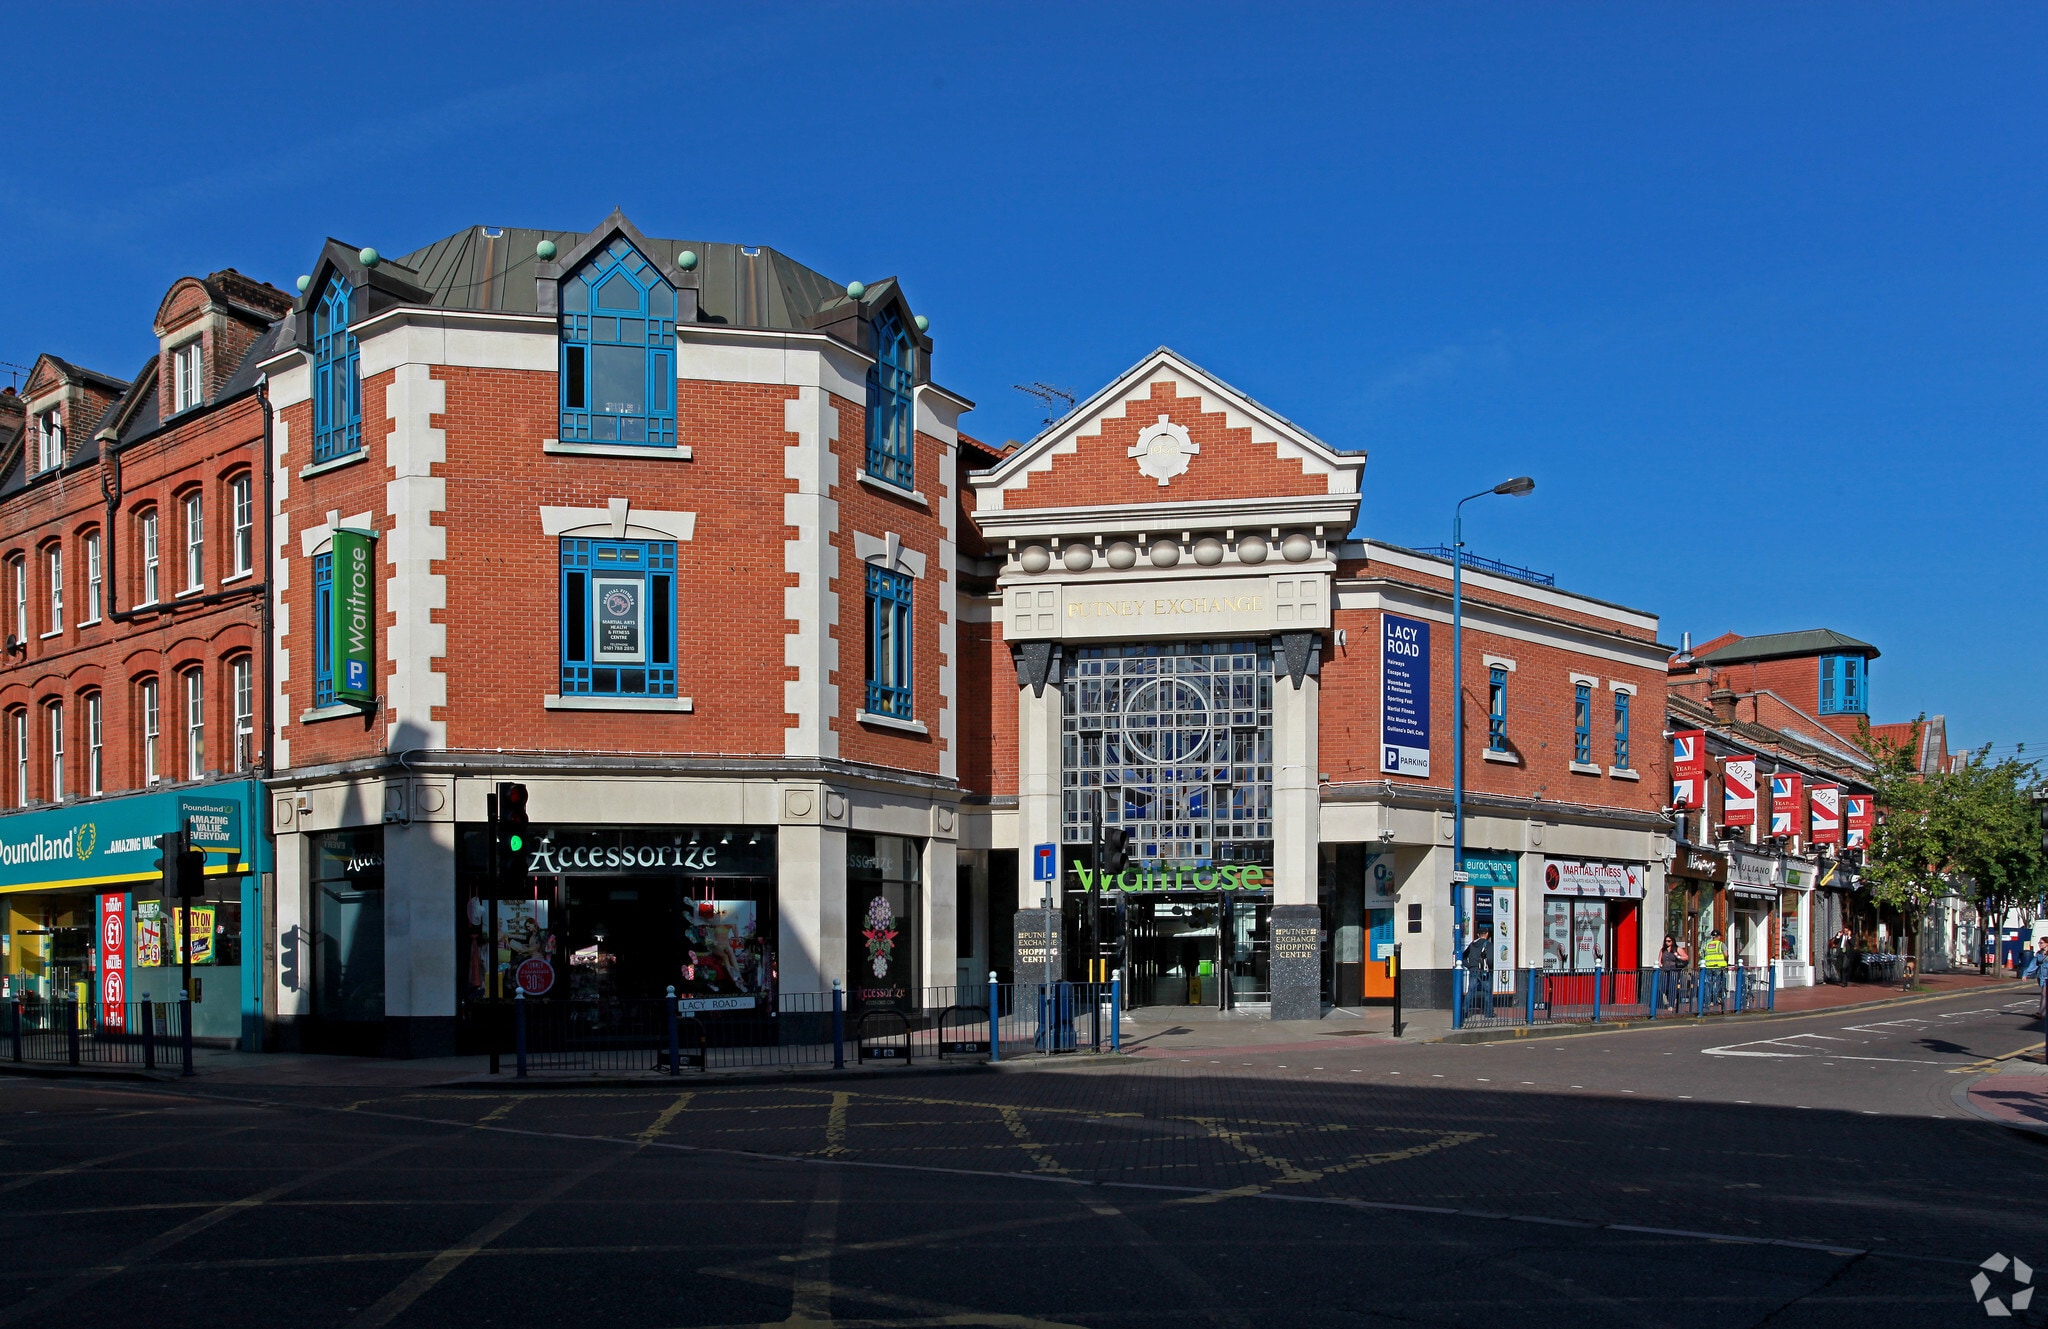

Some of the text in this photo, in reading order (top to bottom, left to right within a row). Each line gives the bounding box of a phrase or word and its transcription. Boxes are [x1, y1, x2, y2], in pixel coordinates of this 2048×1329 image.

[347, 547, 367, 653] Waitrose
[1068, 596, 1264, 618] PUTNEY EXCHANGE
[1387, 623, 1418, 642] LACY
[1387, 638, 1419, 657] ROAD
[350, 661, 362, 680] P
[1387, 705, 1415, 715] Martial Fitness
[1407, 718, 1418, 726] Shop
[1388, 751, 1428, 767] P PARKING
[1729, 762, 1753, 782] 2012
[1815, 791, 1836, 806] 2012
[182, 803, 224, 813] Poundland
[190, 815, 229, 825] AMAZING
[196, 824, 222, 833] VALUE
[142, 835, 162, 850] VAL
[528, 836, 717, 873] Accessorize
[1467, 860, 1512, 873] eurochange
[1563, 865, 1621, 878] MARTIAL FITNESS
[1732, 863, 1770, 875] GIULIANO
[1073, 859, 1264, 894] Waitrose
[200, 912, 211, 926] ON
[108, 923, 120, 945] £1
[1024, 931, 1046, 939] PUTNE
[108, 980, 120, 1002] £1
[682, 1001, 706, 1010] LACY
[712, 999, 738, 1008] ROAD
